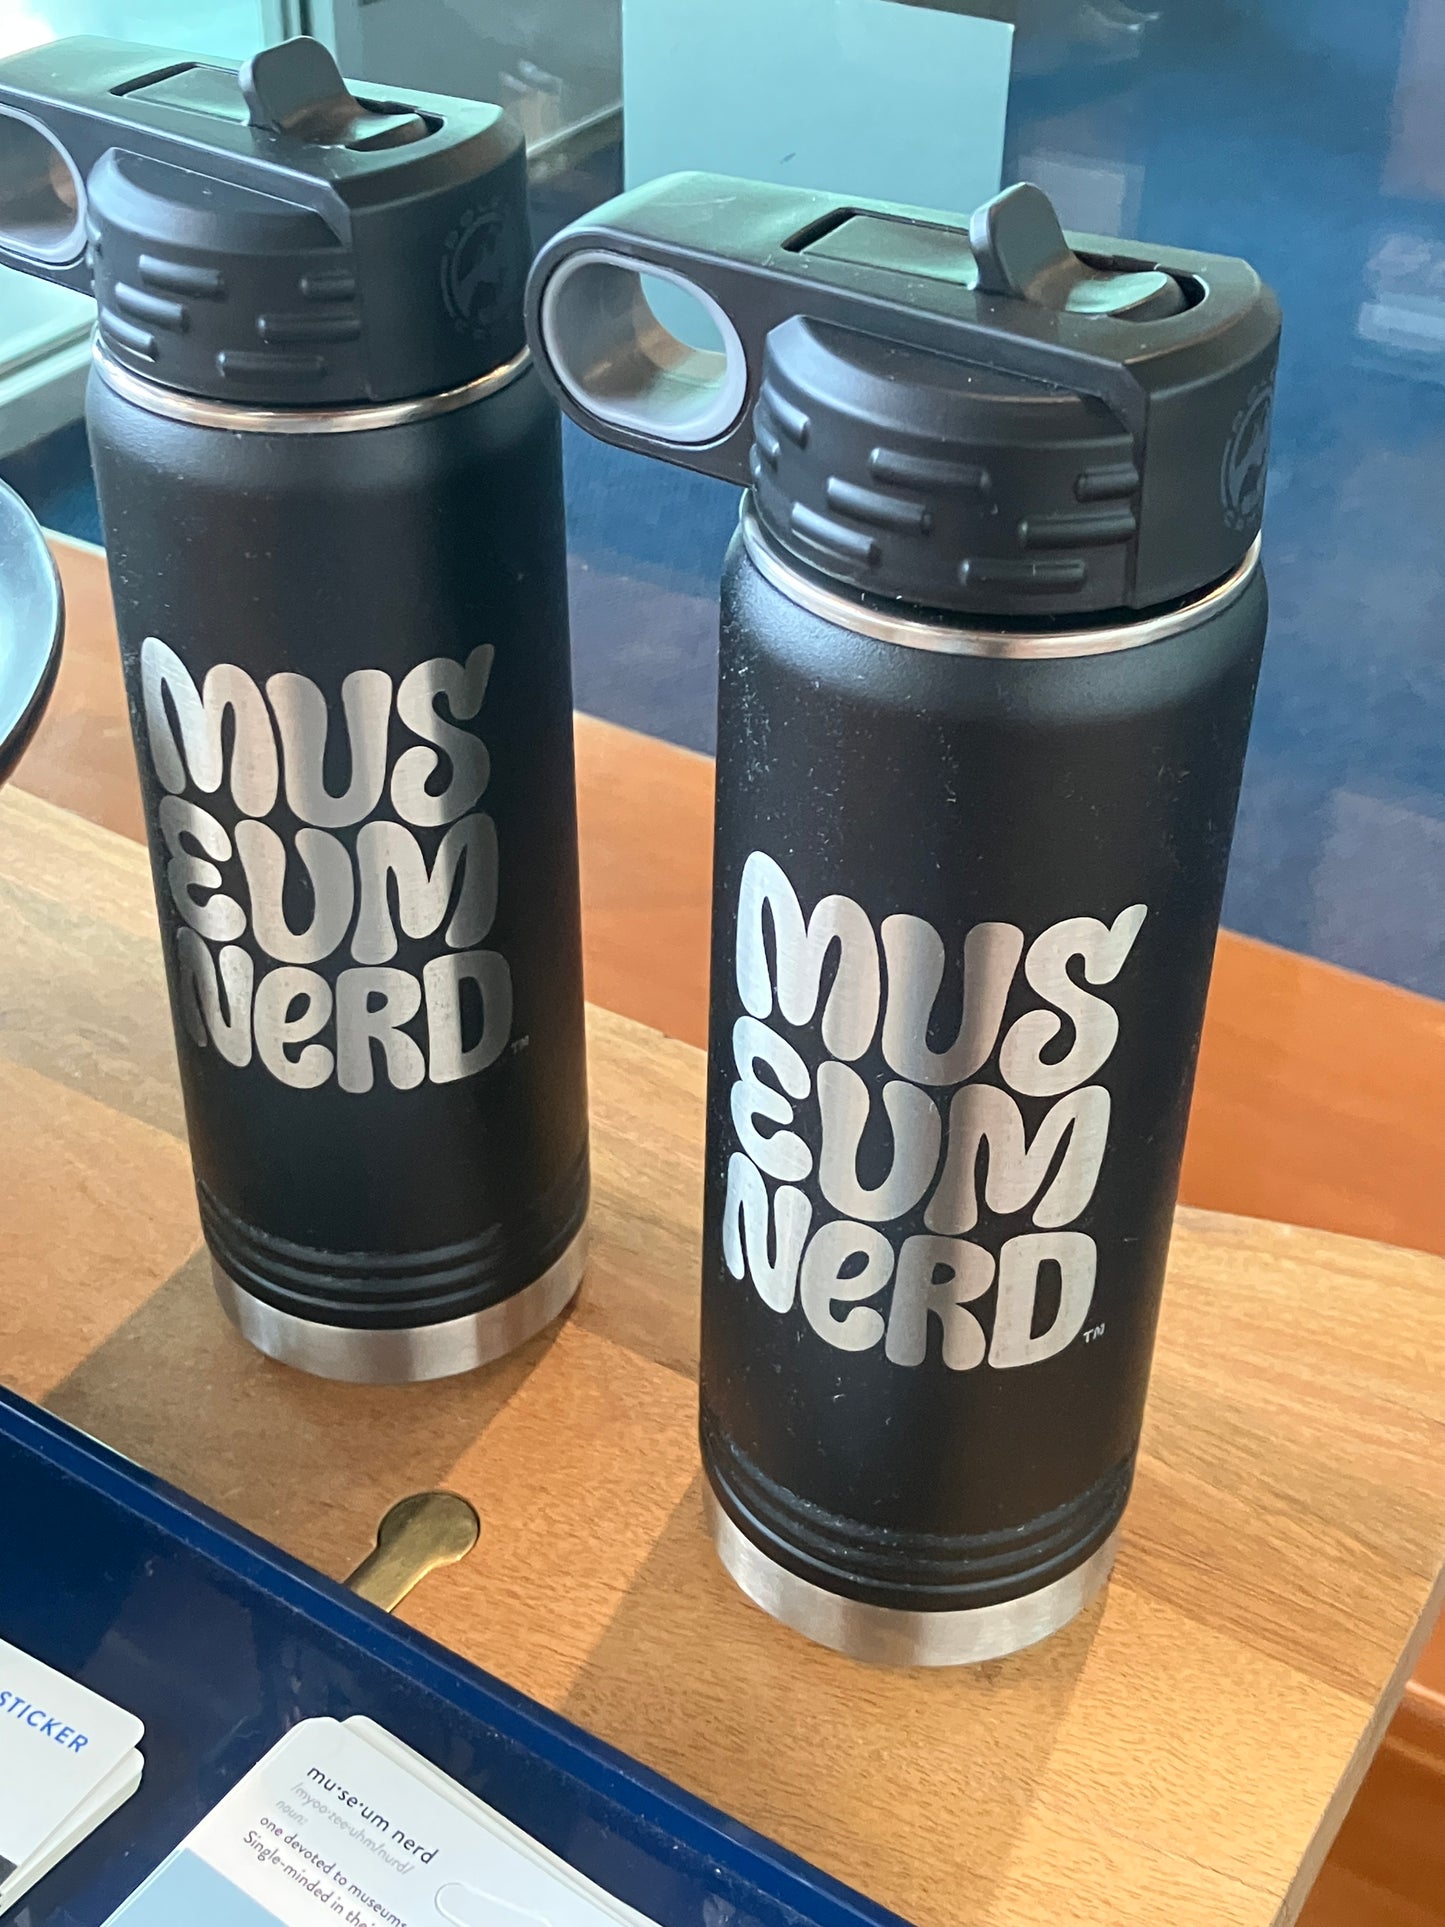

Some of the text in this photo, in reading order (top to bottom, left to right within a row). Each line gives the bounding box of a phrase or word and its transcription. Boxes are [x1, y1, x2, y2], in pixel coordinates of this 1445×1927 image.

[140, 636, 495, 828] MUS
[159, 794, 499, 965] EUM
[735, 850, 1149, 1098] MUS
[730, 1014, 1112, 1235] EUM
[0, 1690, 90, 1753] STICKER
[242, 1829, 335, 1904] Single-minded
[329, 1896, 344, 1915] in
[259, 1816, 283, 1837] one
[283, 1833, 336, 1875] devoted
[333, 1870, 347, 1886] to
[391, 1829, 440, 1865] nerd
